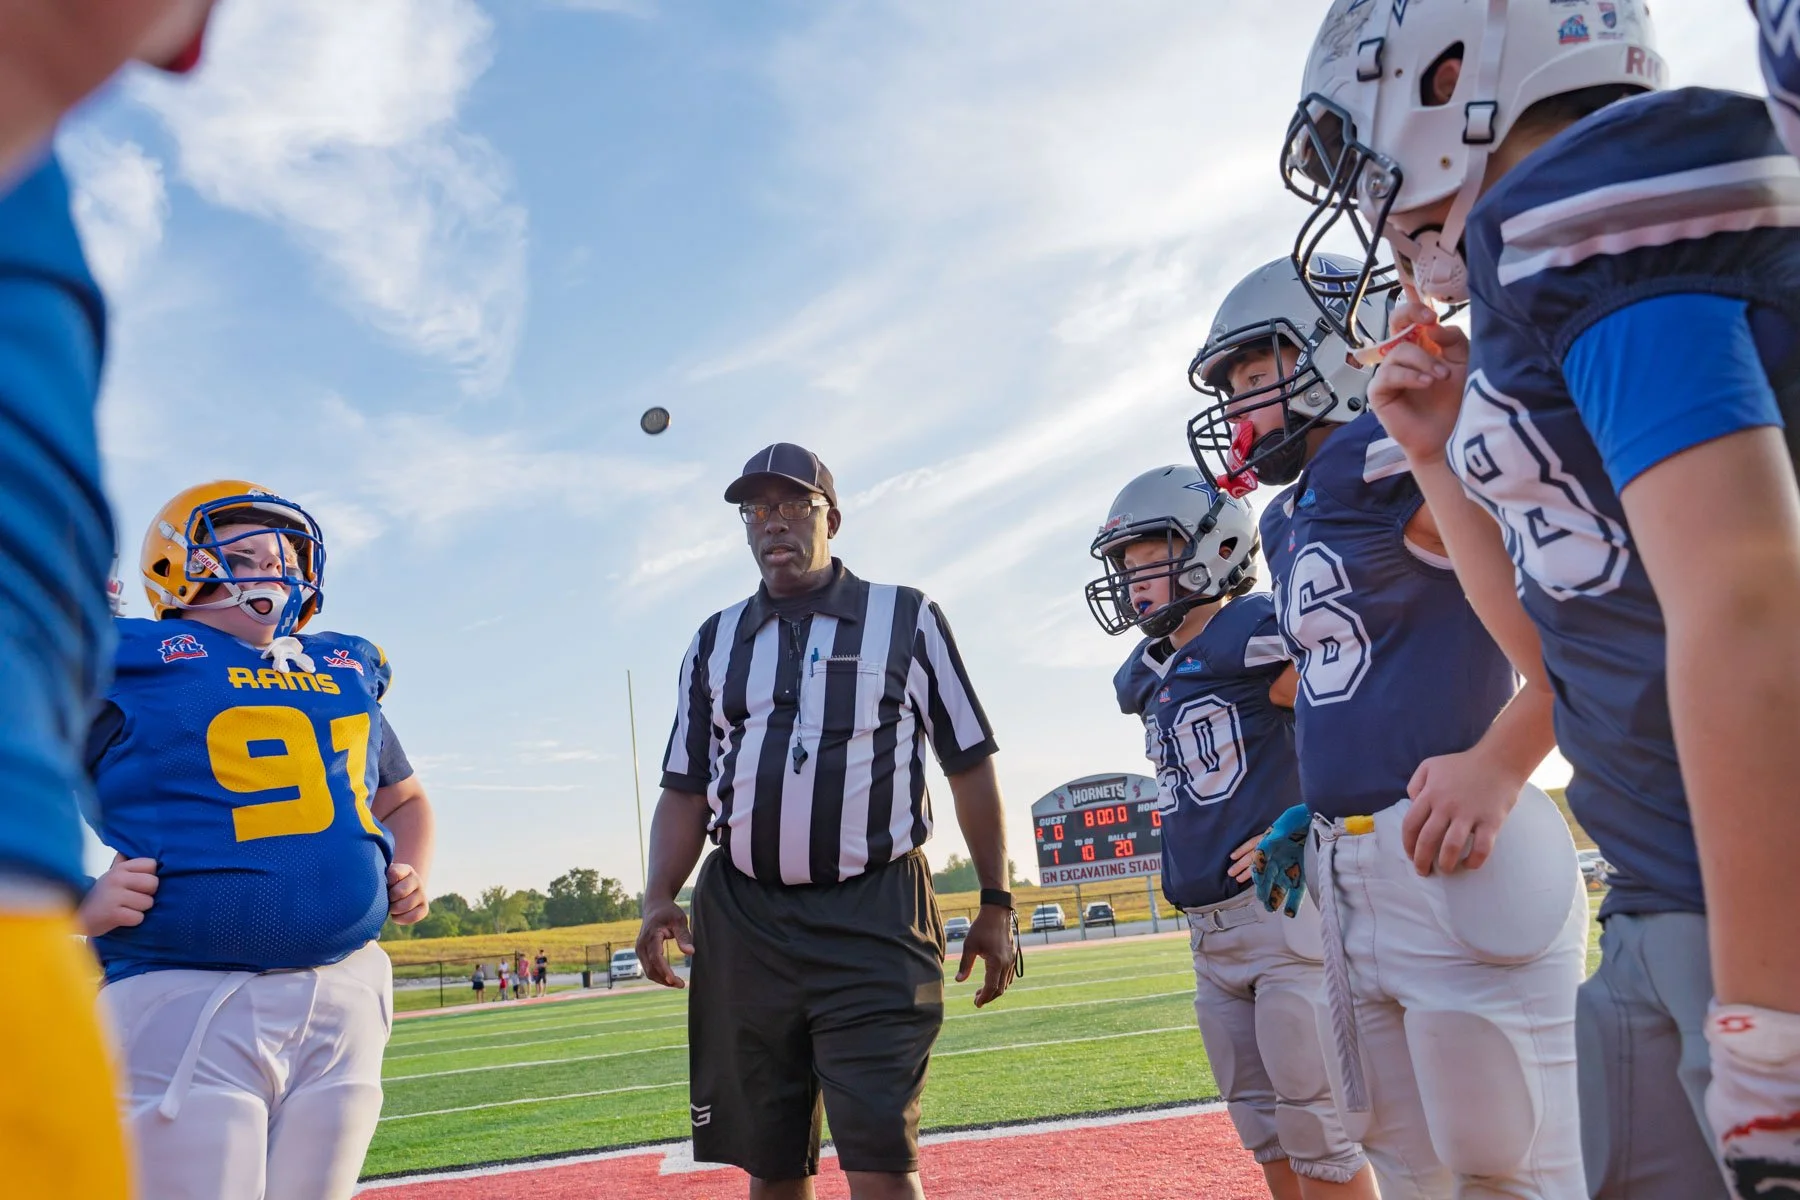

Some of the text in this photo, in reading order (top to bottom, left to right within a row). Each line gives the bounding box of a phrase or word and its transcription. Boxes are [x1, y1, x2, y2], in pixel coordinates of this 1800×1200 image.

[1446, 368, 1630, 602] 8
[193, 548, 218, 572] Riddell
[1274, 541, 1372, 707] 6
[169, 643, 197, 653] KFL
[227, 667, 341, 695] RAMS
[207, 705, 384, 842] 91
[1072, 782, 1125, 806] HORNETS
[1039, 815, 1067, 826] GUEST
[1152, 810, 1161, 827] 0
[1036, 827, 1043, 839] 2
[1054, 825, 1064, 840] 0
[1054, 849, 1059, 864] 1
[1082, 845, 1095, 860] 10
[1115, 840, 1134, 857] 20
[1042, 872, 1057, 884] GN
[1060, 862, 1126, 880] EXCAVATING
